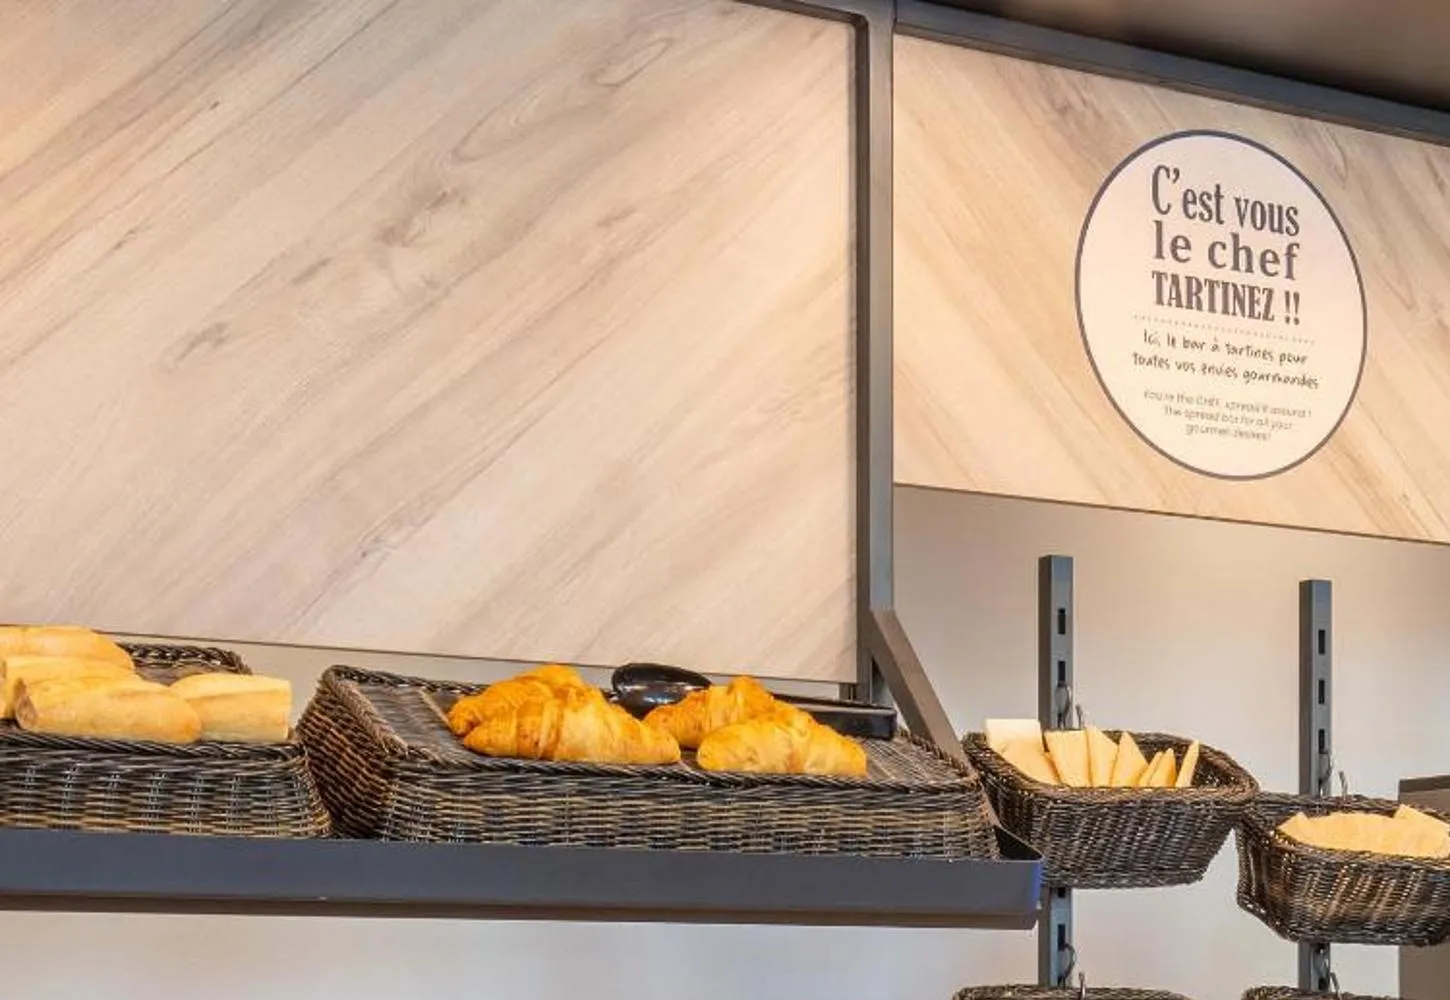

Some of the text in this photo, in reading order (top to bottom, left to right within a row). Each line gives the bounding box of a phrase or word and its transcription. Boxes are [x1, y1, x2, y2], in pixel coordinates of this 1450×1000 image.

[1151, 164, 1300, 237] C'est vous
[1152, 219, 1301, 281] le chef
[1151, 270, 1300, 326] TARTINEZ !!
[1174, 360, 1196, 374] vos
[1242, 369, 1320, 390] gourmandes
[1182, 335, 1206, 352] bar
[1224, 342, 1275, 362] tartines
[1279, 351, 1309, 366] pour
